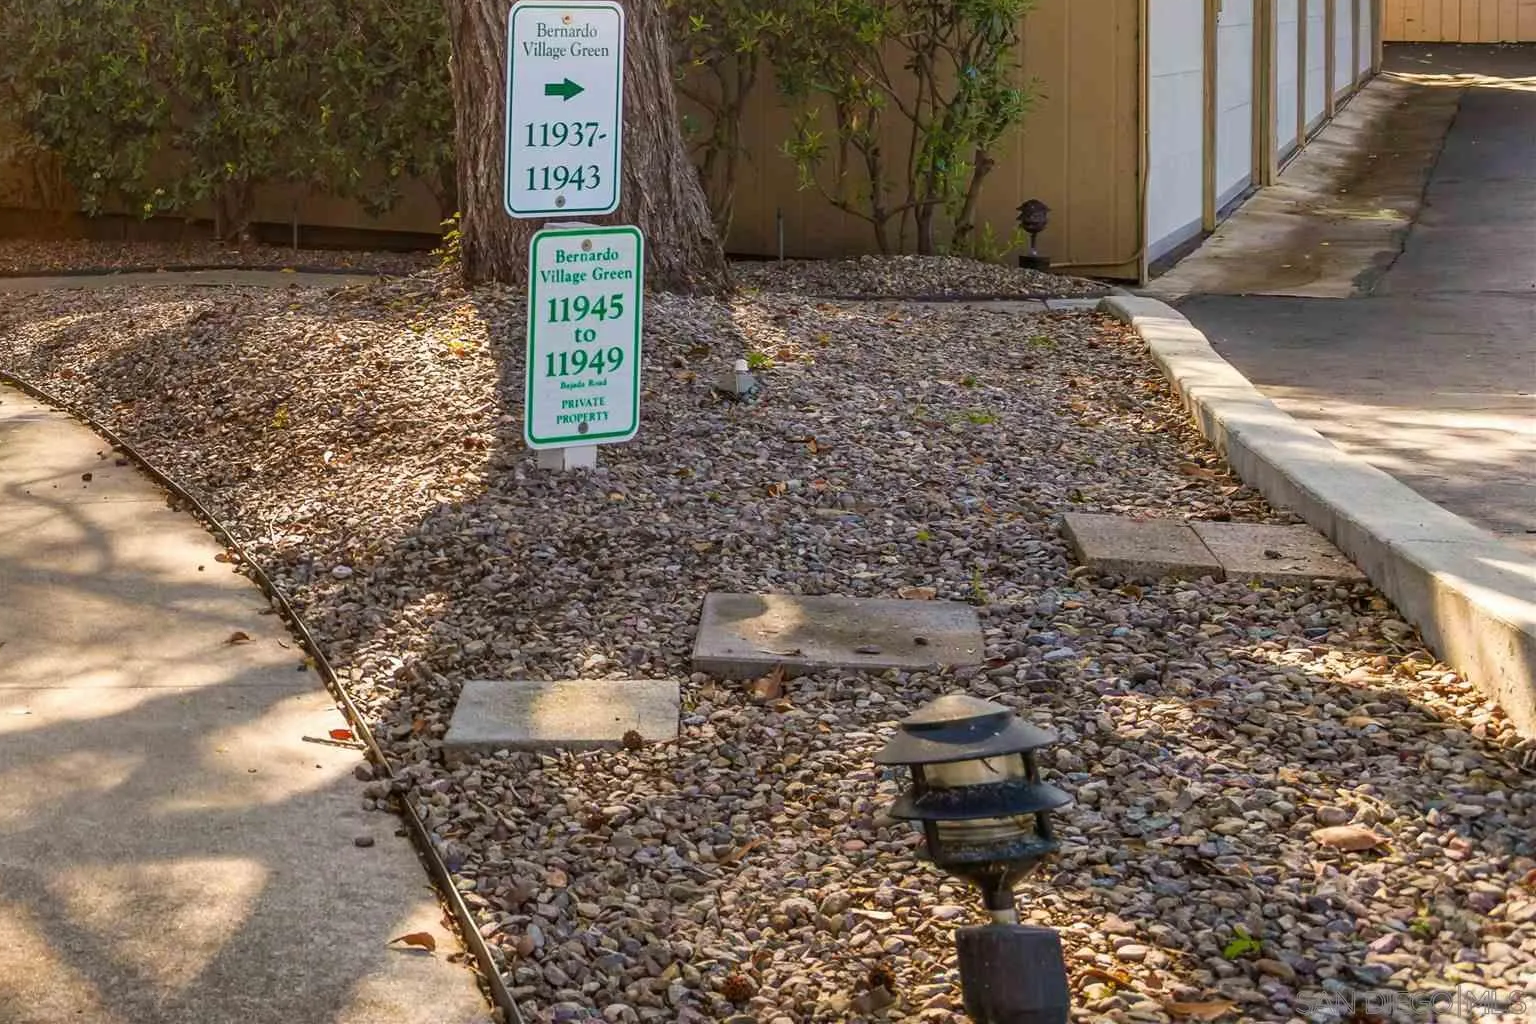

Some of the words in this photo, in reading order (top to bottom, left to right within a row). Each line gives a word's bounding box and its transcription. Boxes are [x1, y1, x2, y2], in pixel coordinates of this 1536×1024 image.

[537, 22, 597, 38] Bernardo
[522, 41, 567, 60] Village
[570, 42, 609, 57] Green
[525, 122, 607, 147] 11937-
[526, 165, 600, 191] 11943
[555, 248, 619, 264] Bernardo
[540, 270, 587, 285] Village
[592, 267, 633, 281] Green
[547, 293, 624, 323] 11945
[574, 328, 596, 343] to
[545, 346, 624, 377] 11949
[561, 396, 606, 409] PRIVATE
[556, 411, 609, 425] PROPERTY
